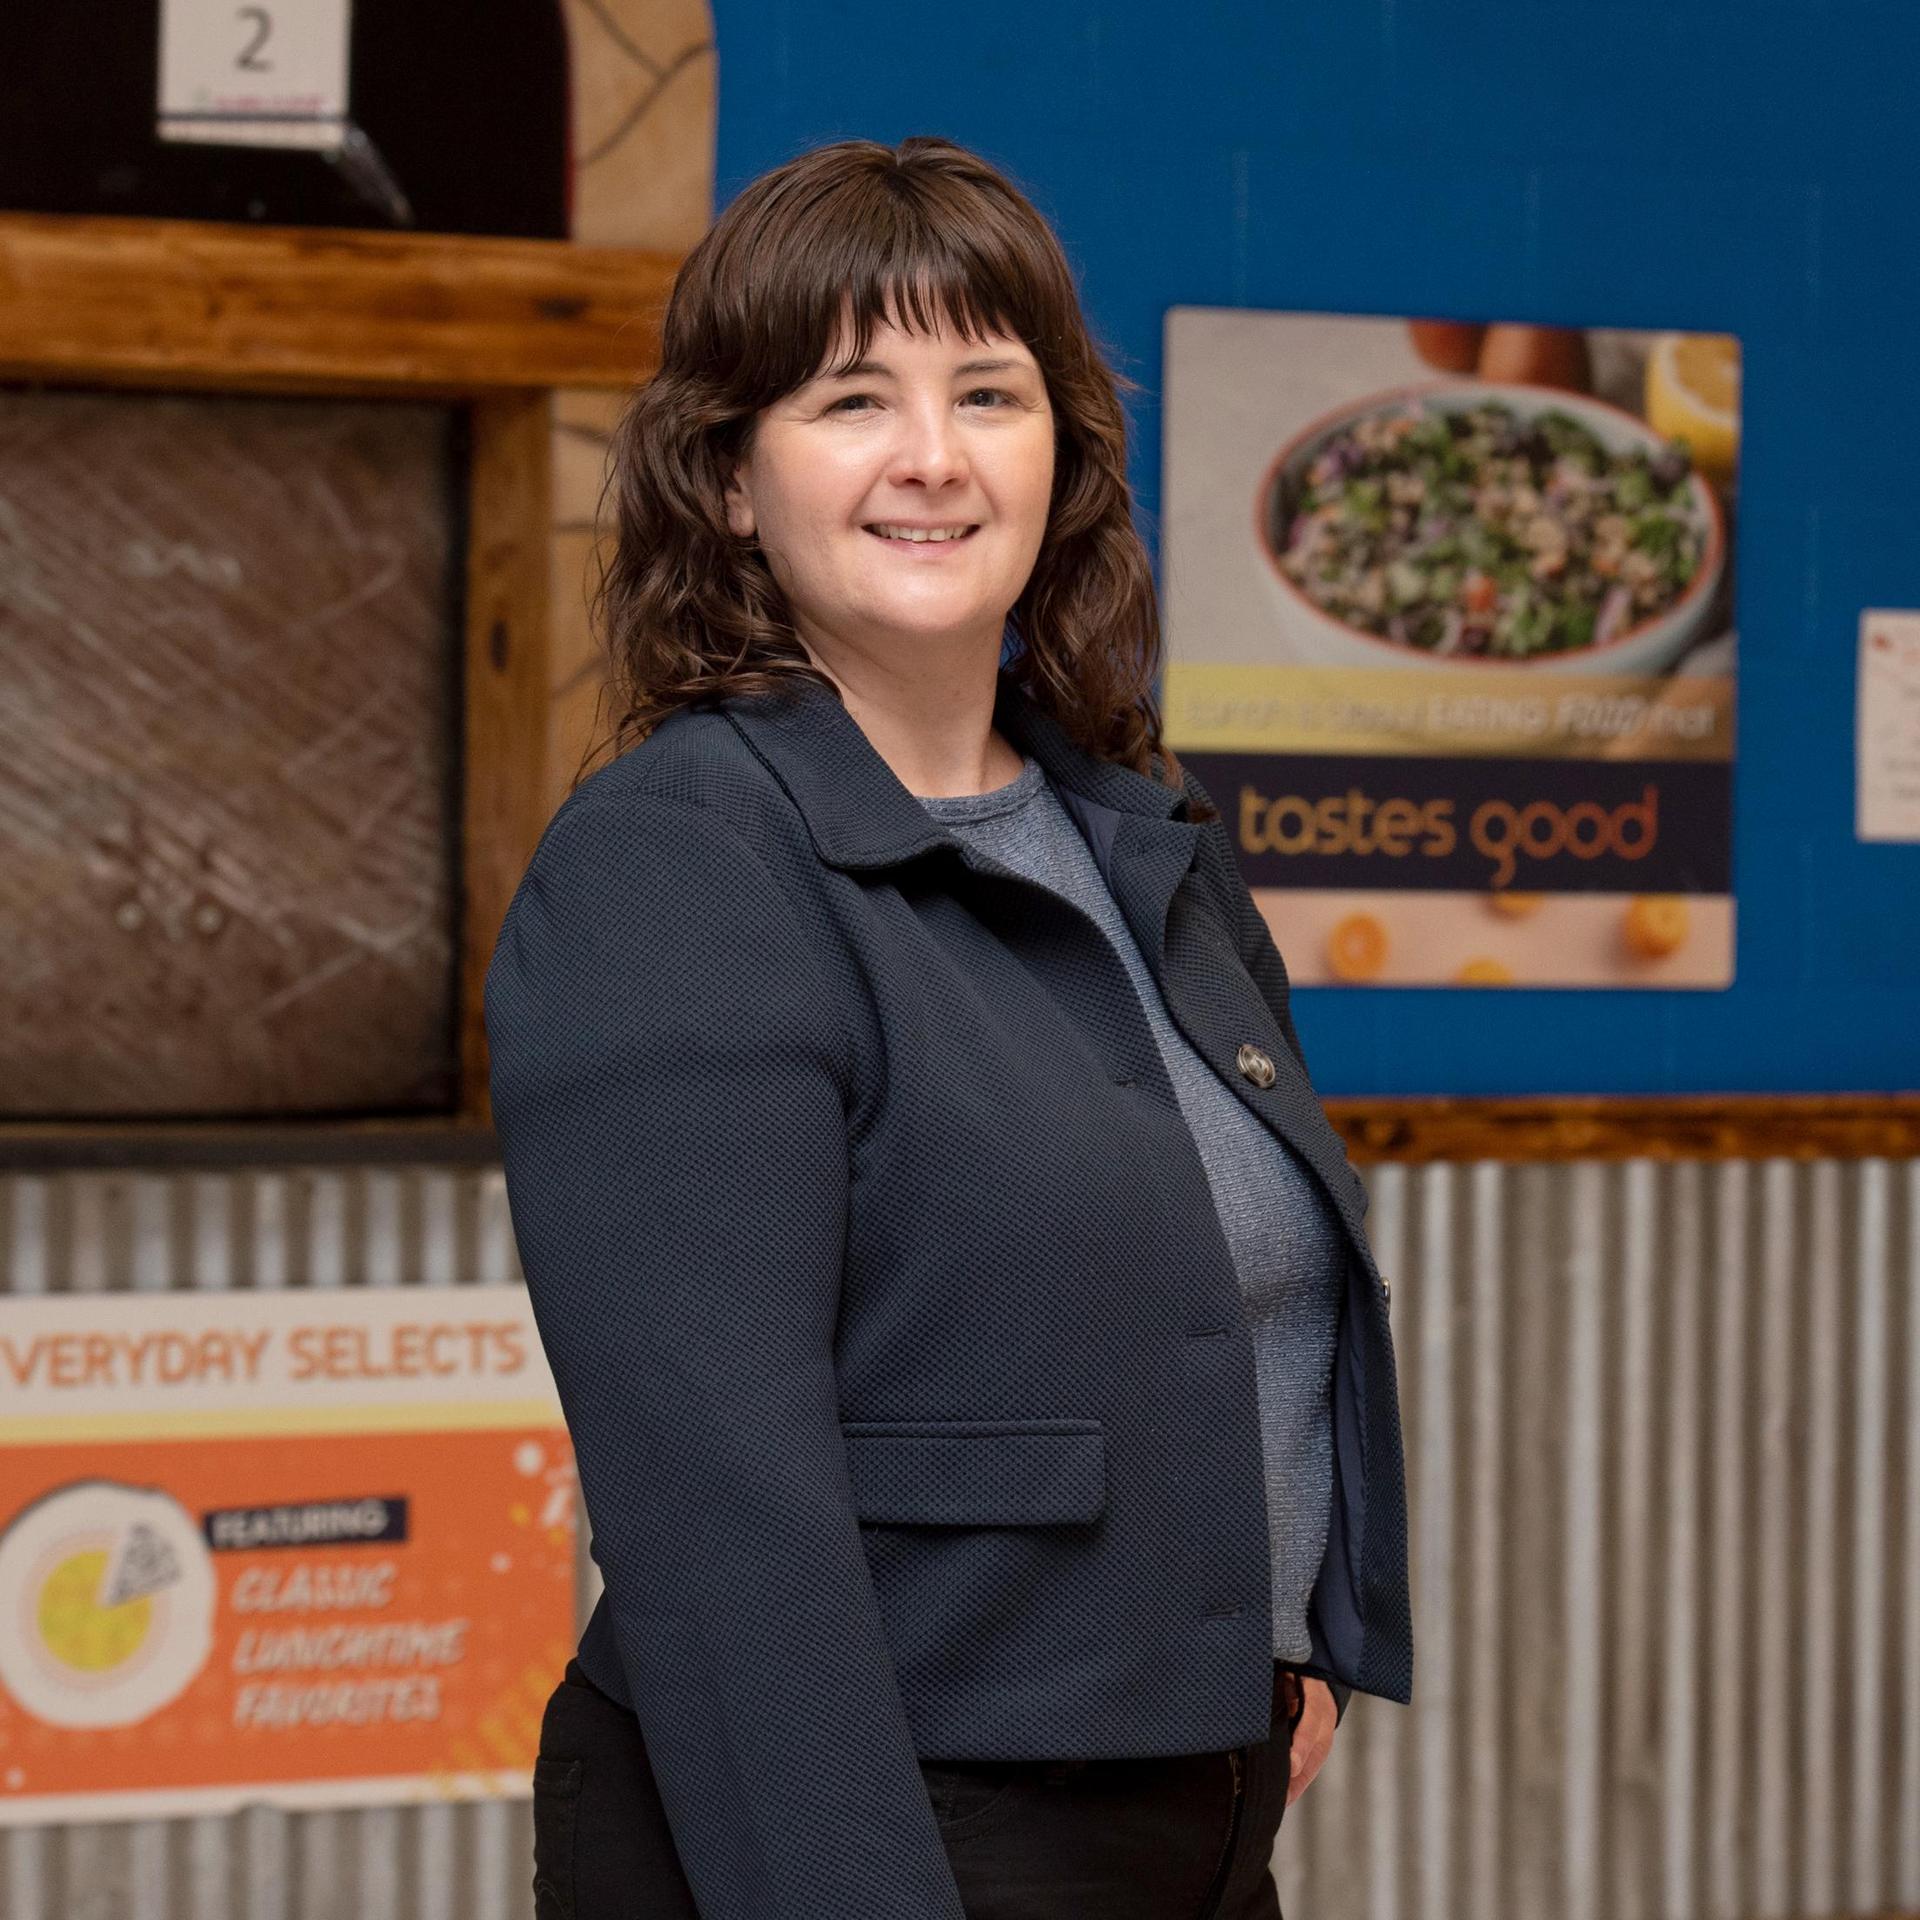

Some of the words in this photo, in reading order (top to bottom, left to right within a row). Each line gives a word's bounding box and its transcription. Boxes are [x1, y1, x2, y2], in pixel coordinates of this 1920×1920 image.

[236, 7, 274, 70] 2
[1239, 786, 1456, 856] tastes
[1470, 786, 1659, 886] good
[286, 1323, 528, 1380] SELECTS
[211, 1499, 391, 1549] FEATURING
[234, 1565, 393, 1611] CLASSIC
[235, 1622, 466, 1672] LUNCHTIME
[235, 1679, 440, 1727] FAVORITES
